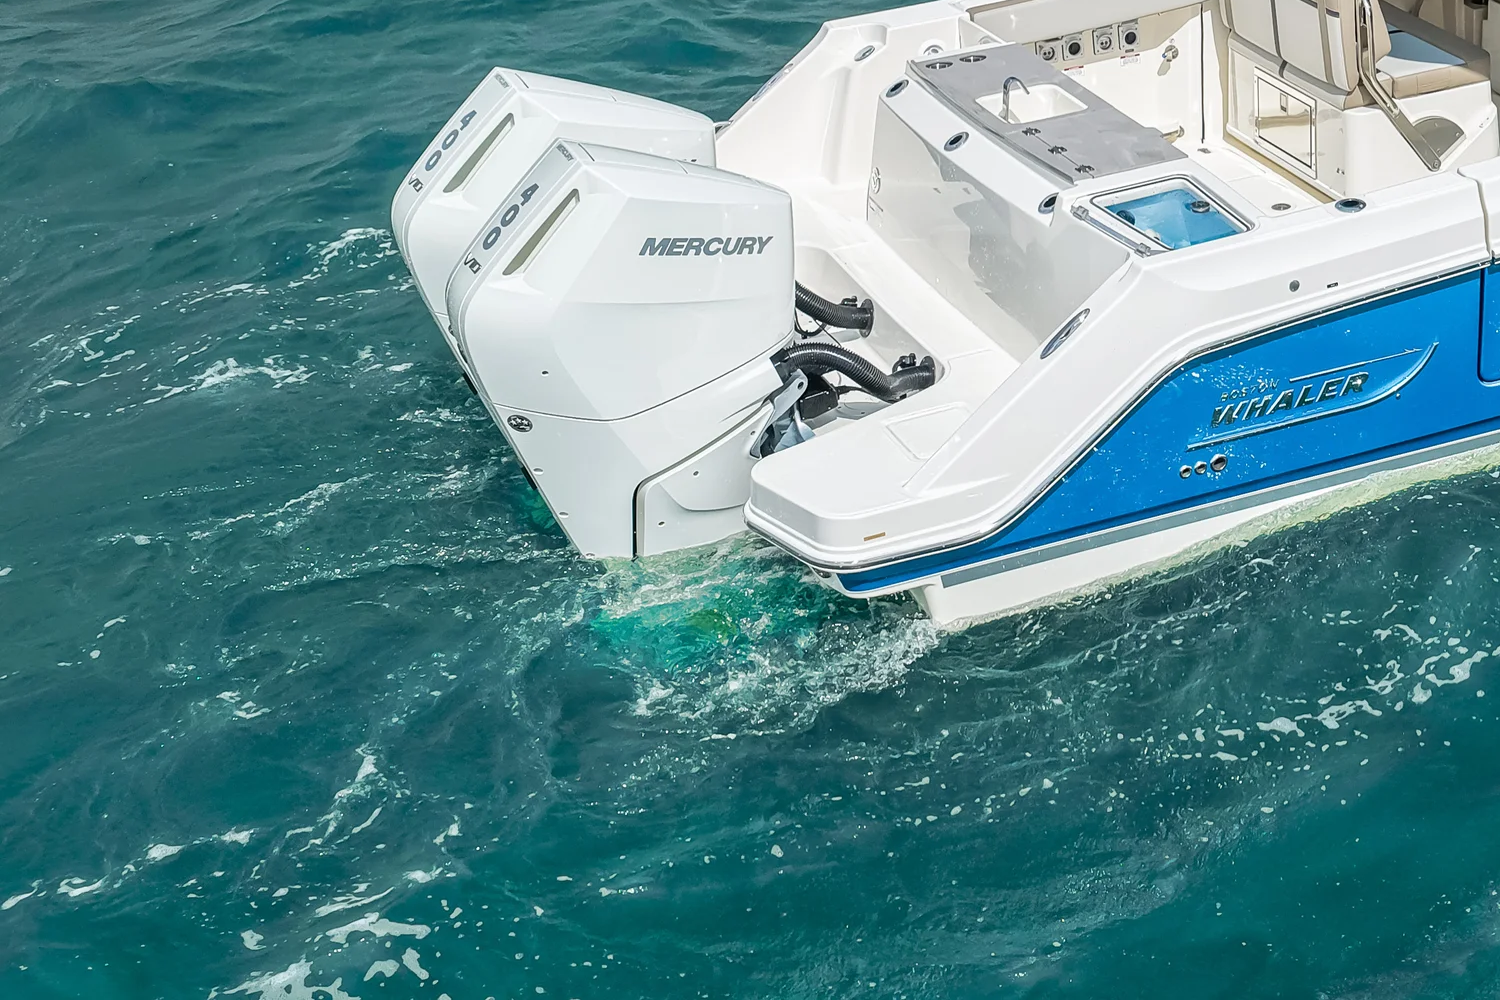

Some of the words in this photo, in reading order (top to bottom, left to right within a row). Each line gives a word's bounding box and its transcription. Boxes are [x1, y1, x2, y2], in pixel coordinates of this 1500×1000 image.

[425, 110, 477, 171] 400
[482, 183, 539, 250] 400
[639, 236, 774, 256] MERCURY
[1211, 371, 1369, 428] WHALER
